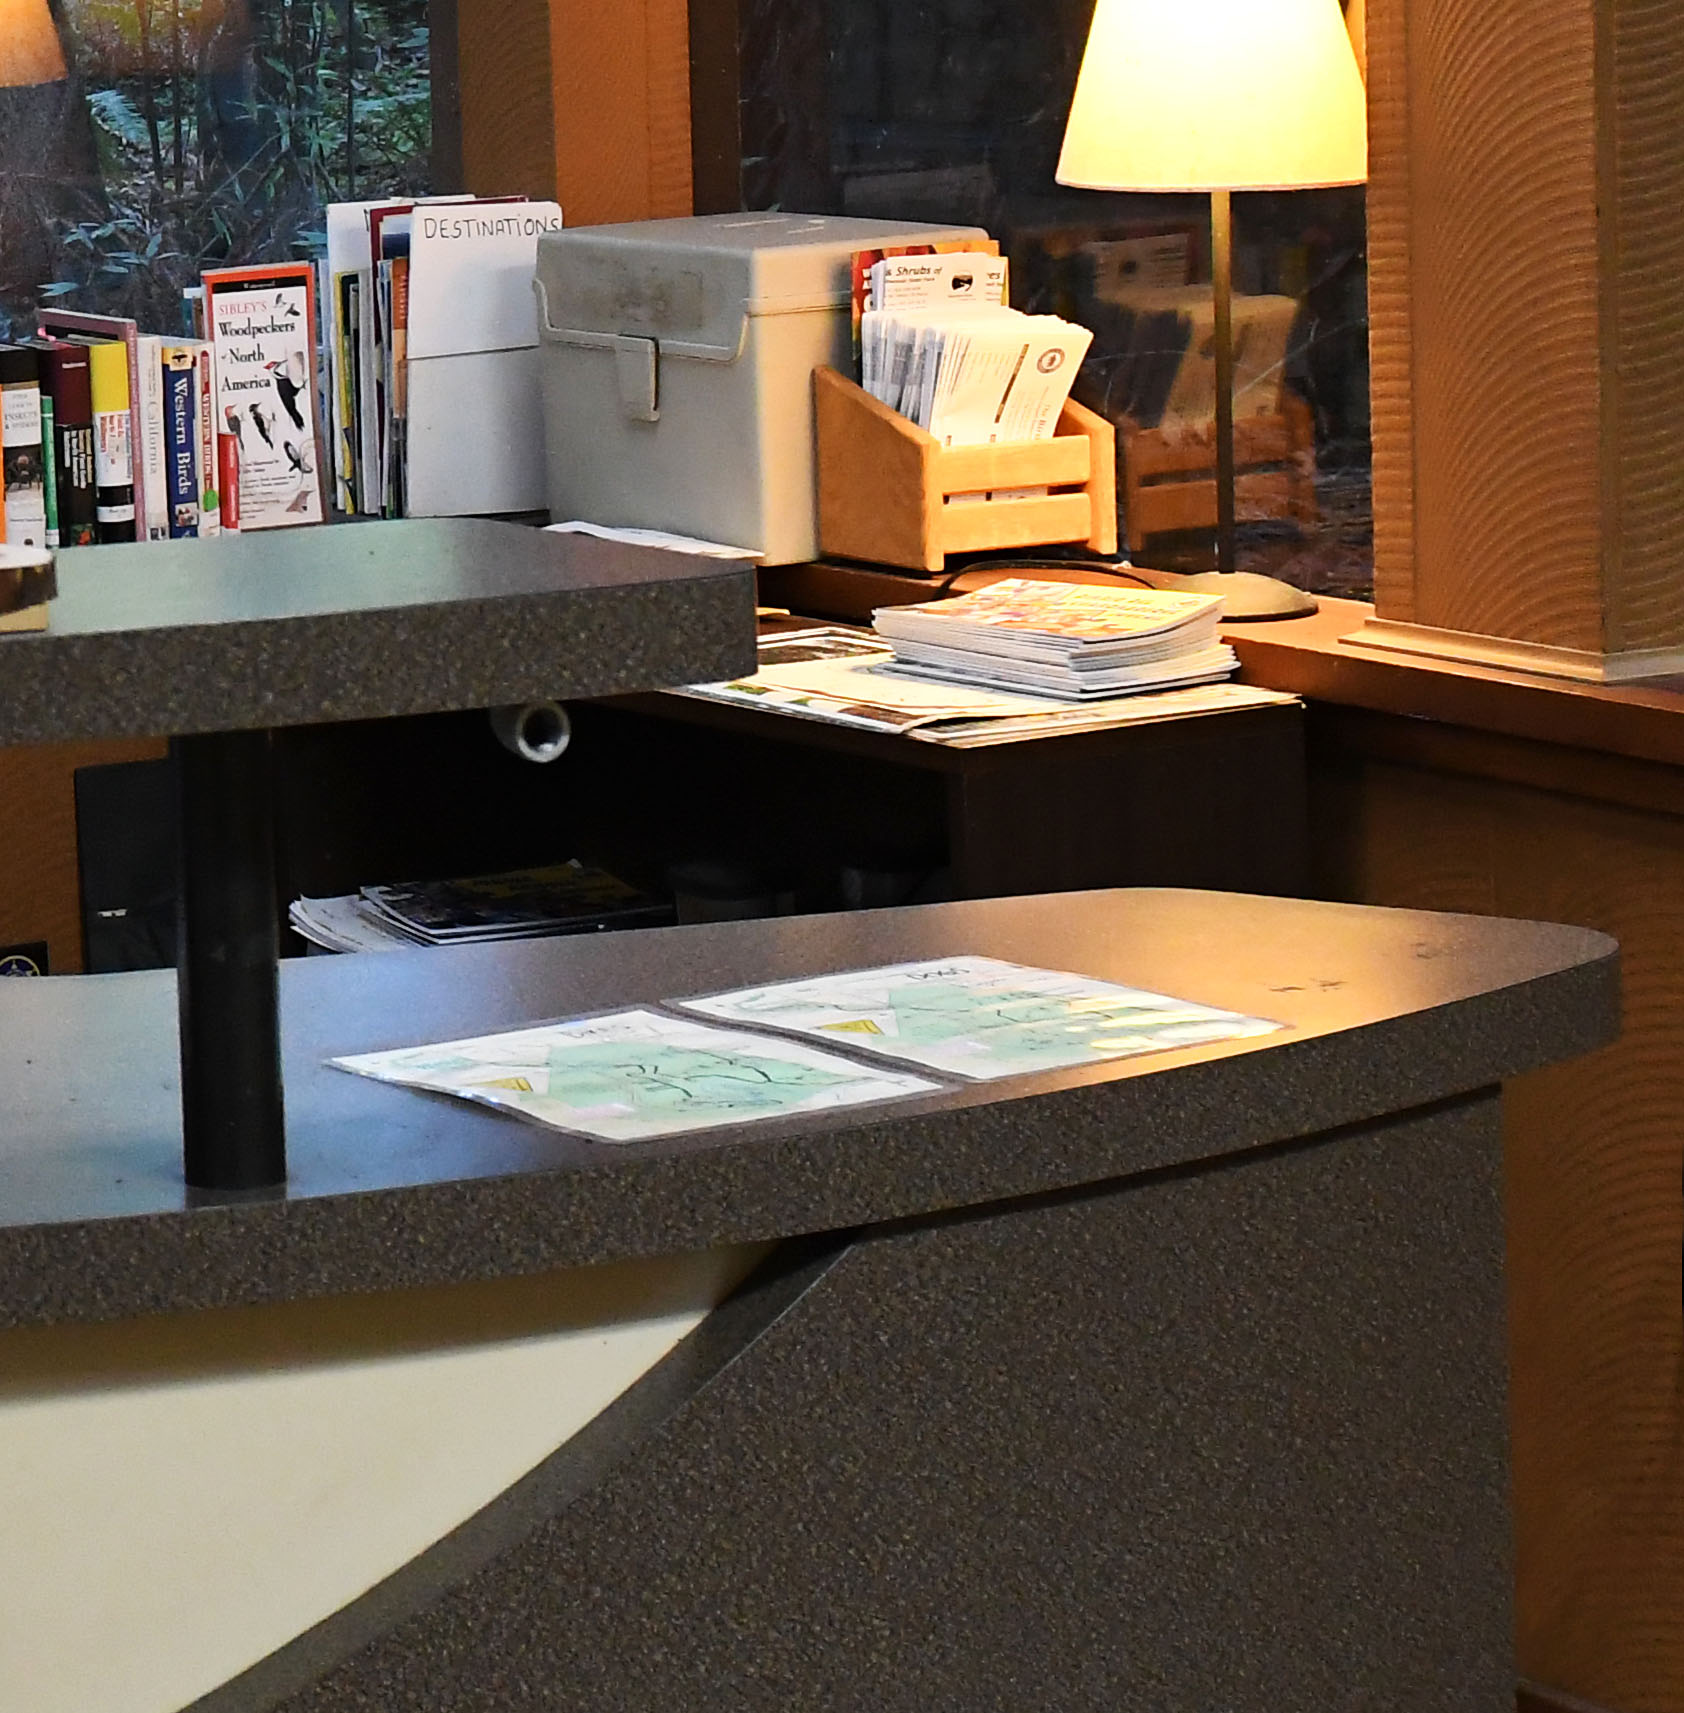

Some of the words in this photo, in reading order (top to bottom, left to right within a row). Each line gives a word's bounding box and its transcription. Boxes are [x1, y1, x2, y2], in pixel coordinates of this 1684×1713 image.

[895, 265, 931, 277] Shrubs
[218, 300, 267, 316] SIBLEY'S
[218, 315, 296, 340] Woodpeckers
[229, 343, 265, 365] North
[221, 375, 272, 393] America
[173, 376, 189, 446] Western
[177, 451, 193, 496] Birds
